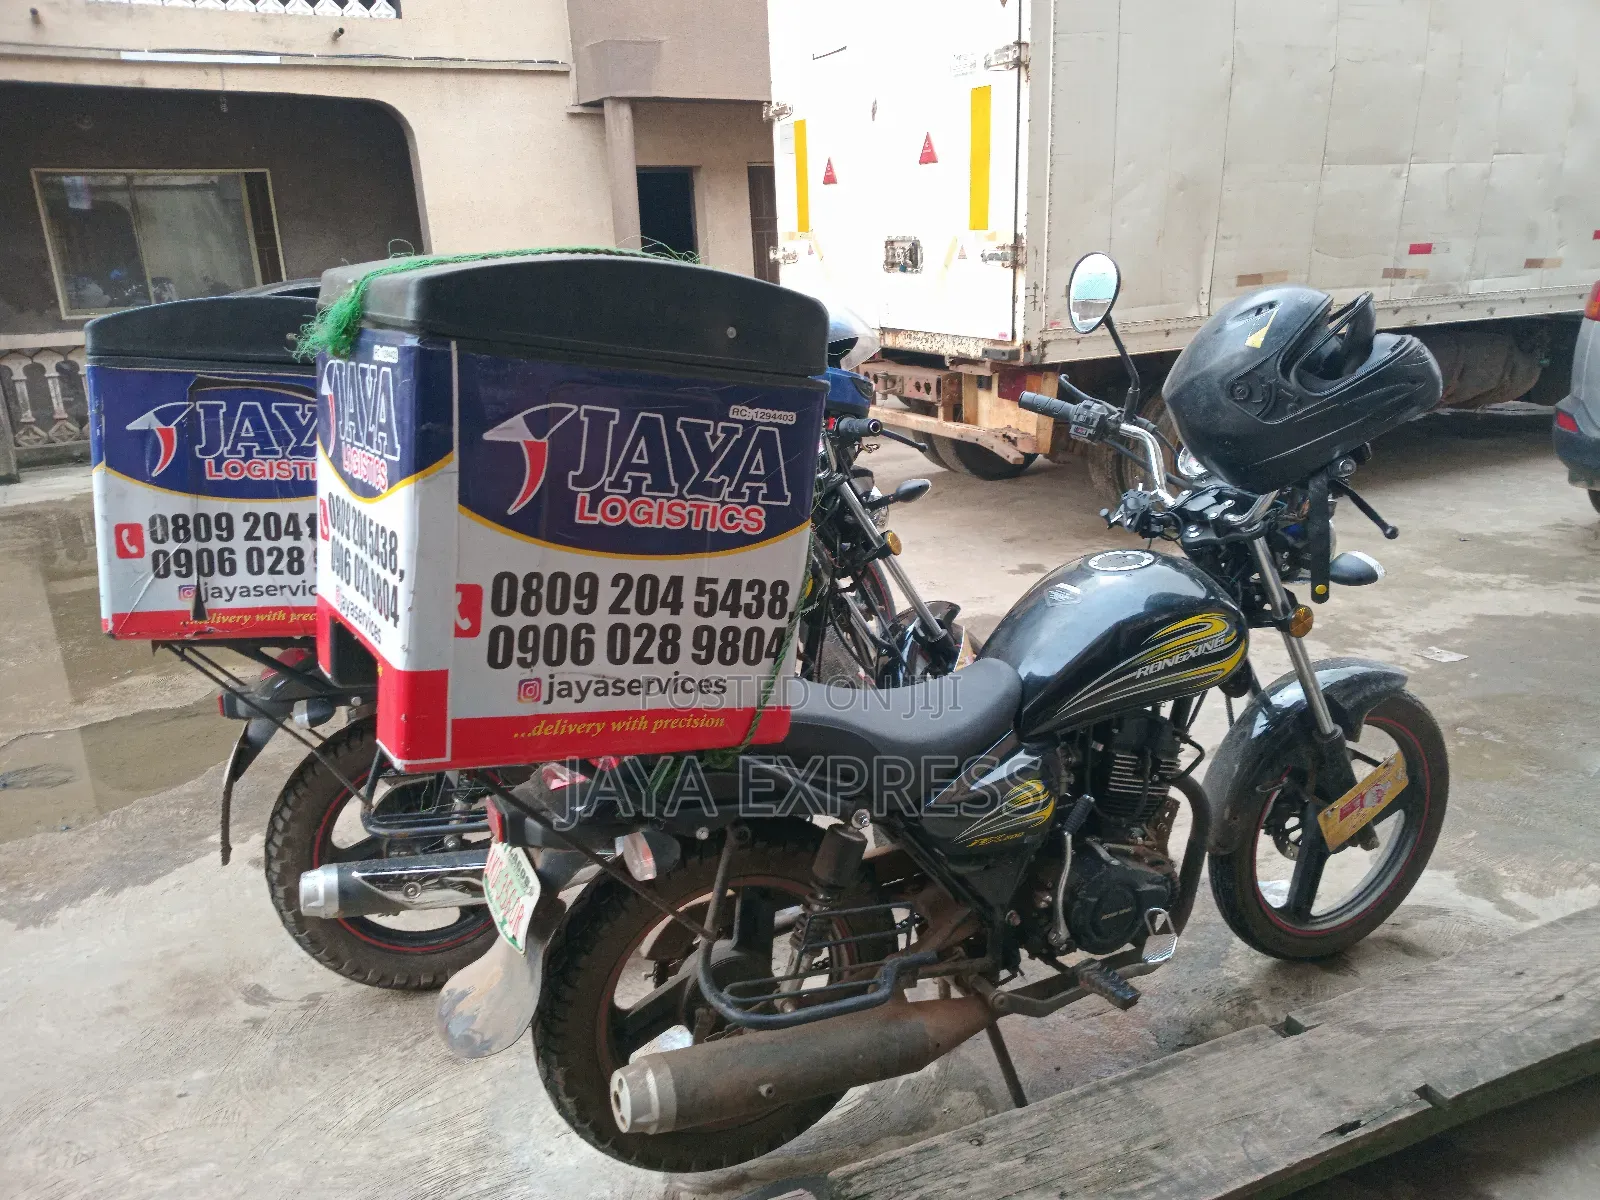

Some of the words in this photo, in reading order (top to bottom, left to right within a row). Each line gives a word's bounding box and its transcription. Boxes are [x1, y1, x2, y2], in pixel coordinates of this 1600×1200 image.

[336, 360, 400, 461] JAYA
[732, 407, 751, 418] RC:
[754, 410, 794, 422] 1294403
[342, 440, 388, 493] LOGISTICS
[569, 405, 791, 505] JAYA
[149, 512, 235, 544] 0809
[243, 512, 303, 541] 204
[574, 494, 766, 534] LOGISTICS
[152, 547, 237, 579] 0906
[246, 546, 305, 576] 028
[371, 568, 399, 628] 9804
[491, 571, 599, 617] 0809
[608, 573, 684, 616] 204
[255, 610, 285, 623] with
[339, 594, 382, 644] jayaservices
[487, 623, 595, 669] 0906
[606, 623, 681, 665] 028
[691, 625, 786, 667] 9804
[543, 671, 727, 704] jayaservices
[514, 718, 605, 738] ...delivery
[611, 715, 648, 732] with
[651, 714, 725, 734] precision
